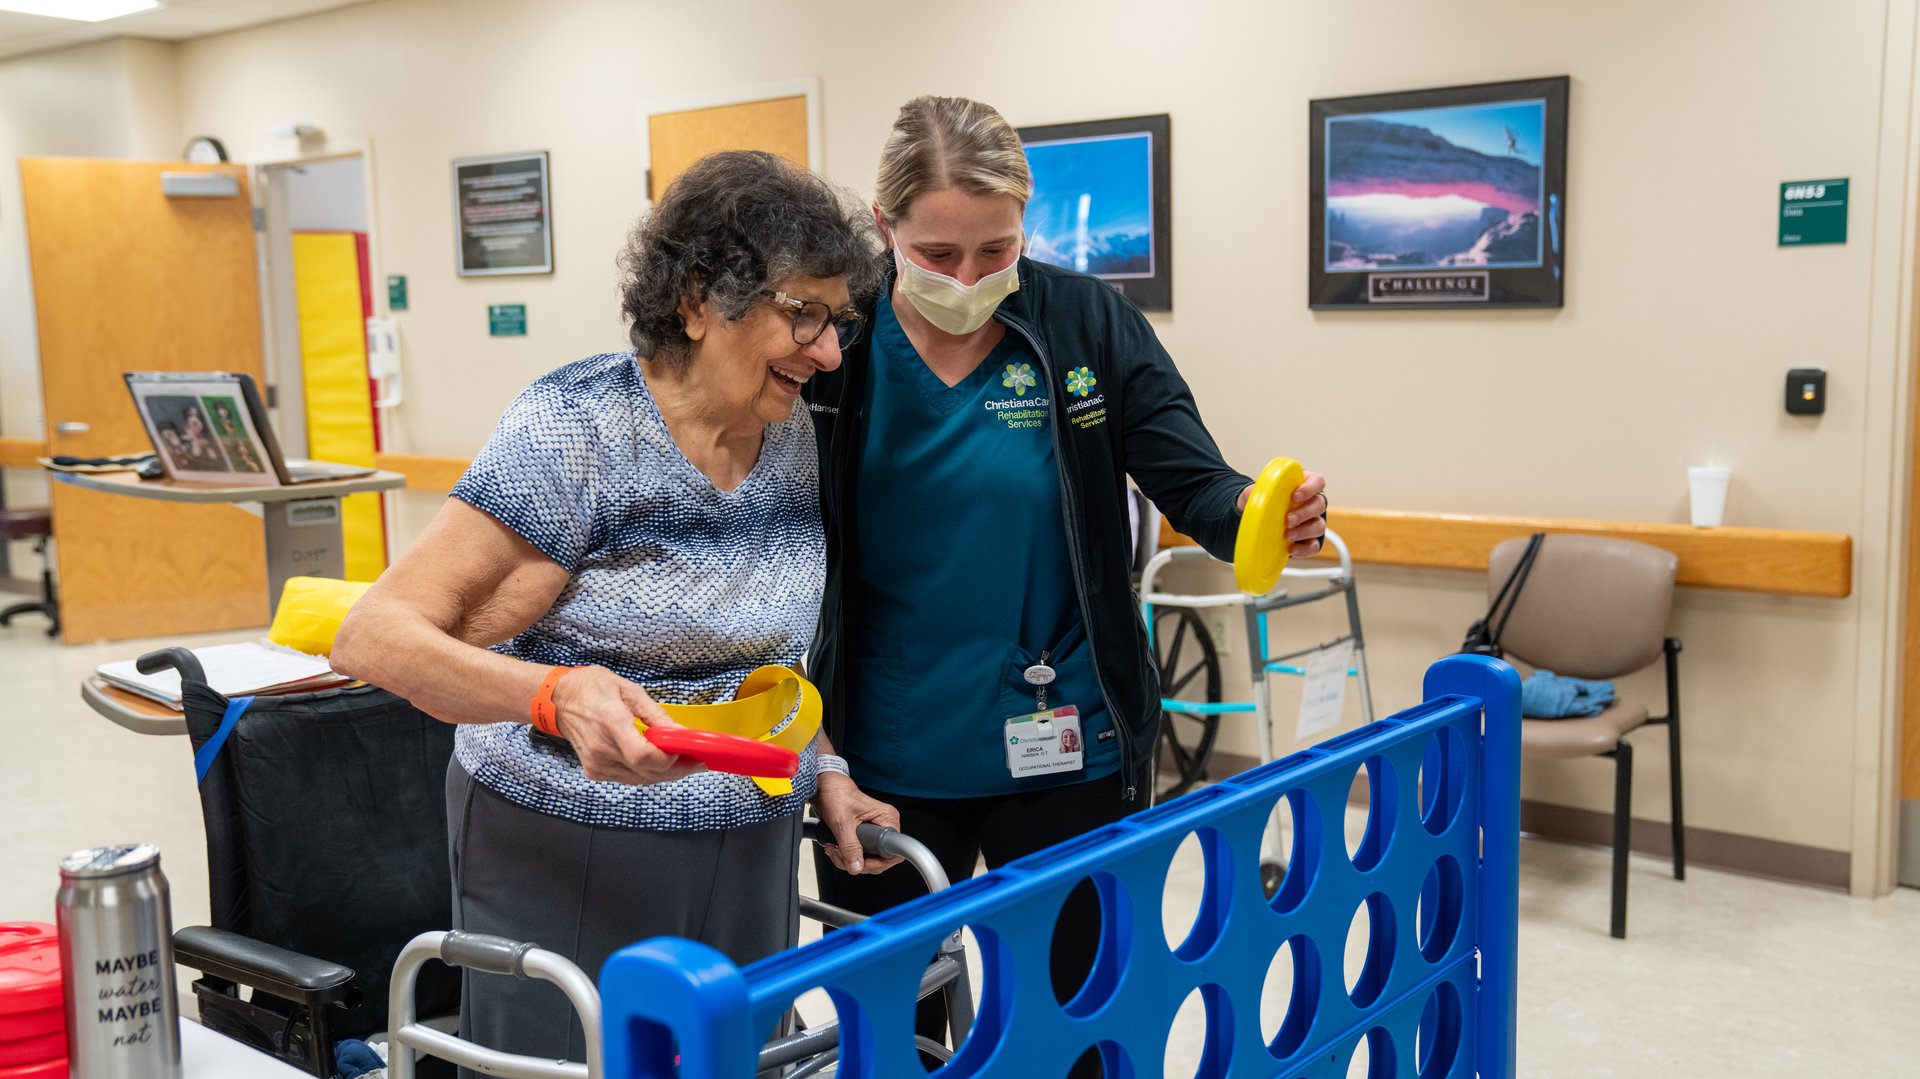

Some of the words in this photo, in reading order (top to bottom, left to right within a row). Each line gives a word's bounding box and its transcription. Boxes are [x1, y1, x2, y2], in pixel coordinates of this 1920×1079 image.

[1379, 278, 1479, 290] CHALLENGE
[984, 397, 1050, 410] ChristianaCar
[997, 409, 1048, 420] Rehabilitation
[1007, 419, 1042, 429] Services
[96, 950, 158, 975] MAYBE
[99, 976, 160, 1000] water
[98, 997, 161, 1024] MAYBE
[114, 1021, 151, 1048] not
